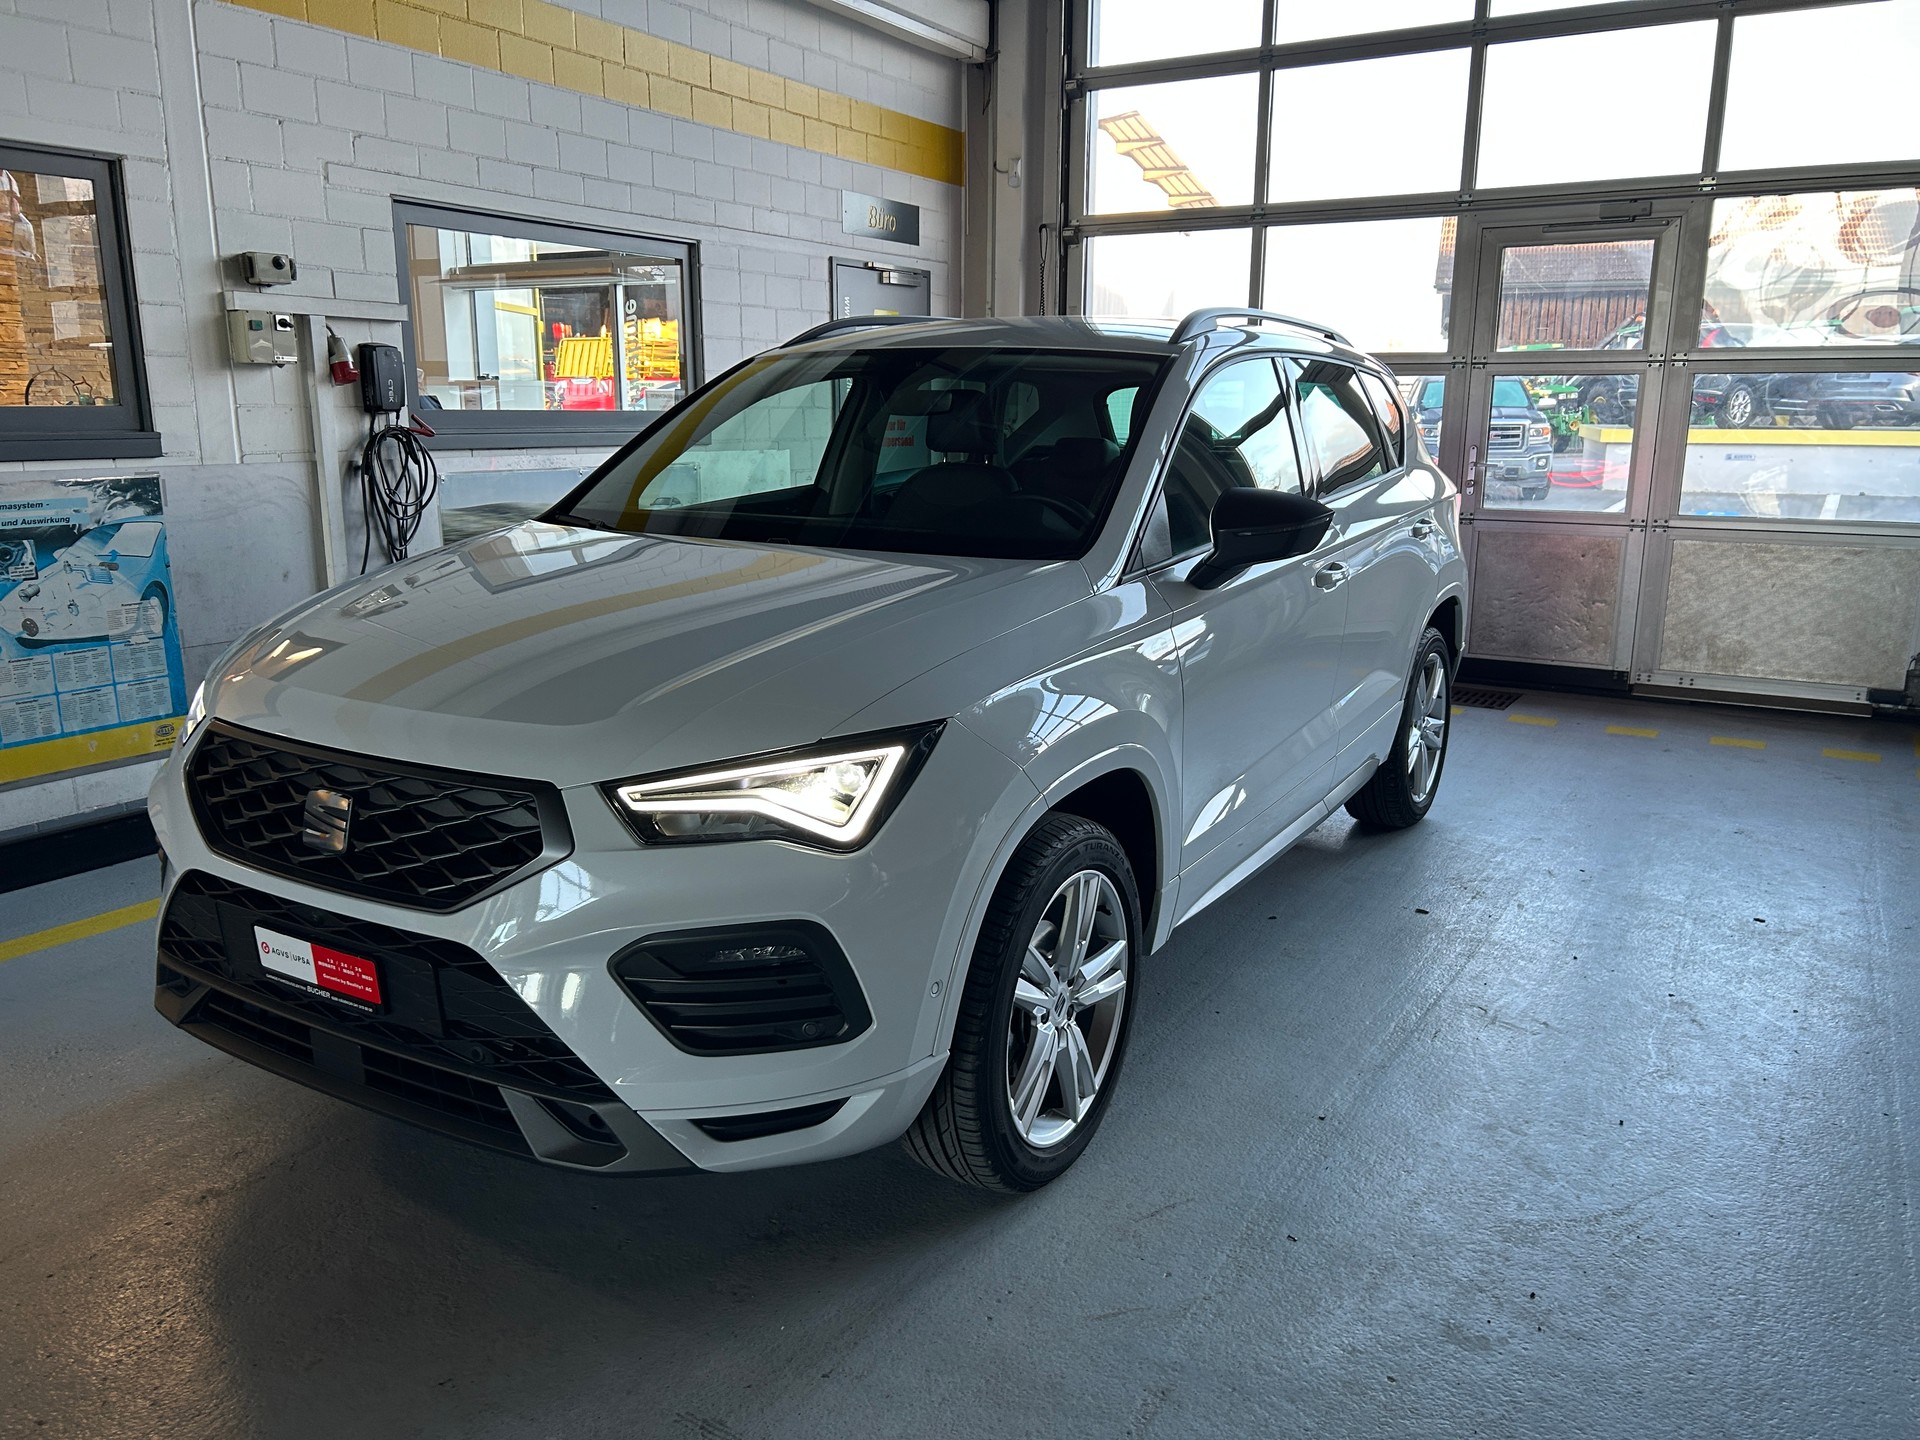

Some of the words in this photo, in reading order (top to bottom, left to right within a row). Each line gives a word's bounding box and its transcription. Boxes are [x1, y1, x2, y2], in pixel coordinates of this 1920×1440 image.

[868, 205, 898, 232] Büro
[387, 378, 395, 403] CTEK
[1, 519, 19, 527] und
[20, 516, 71, 526] Auswirkung
[1083, 842, 1126, 866] TURANZA
[306, 985, 331, 999] BUCHER
